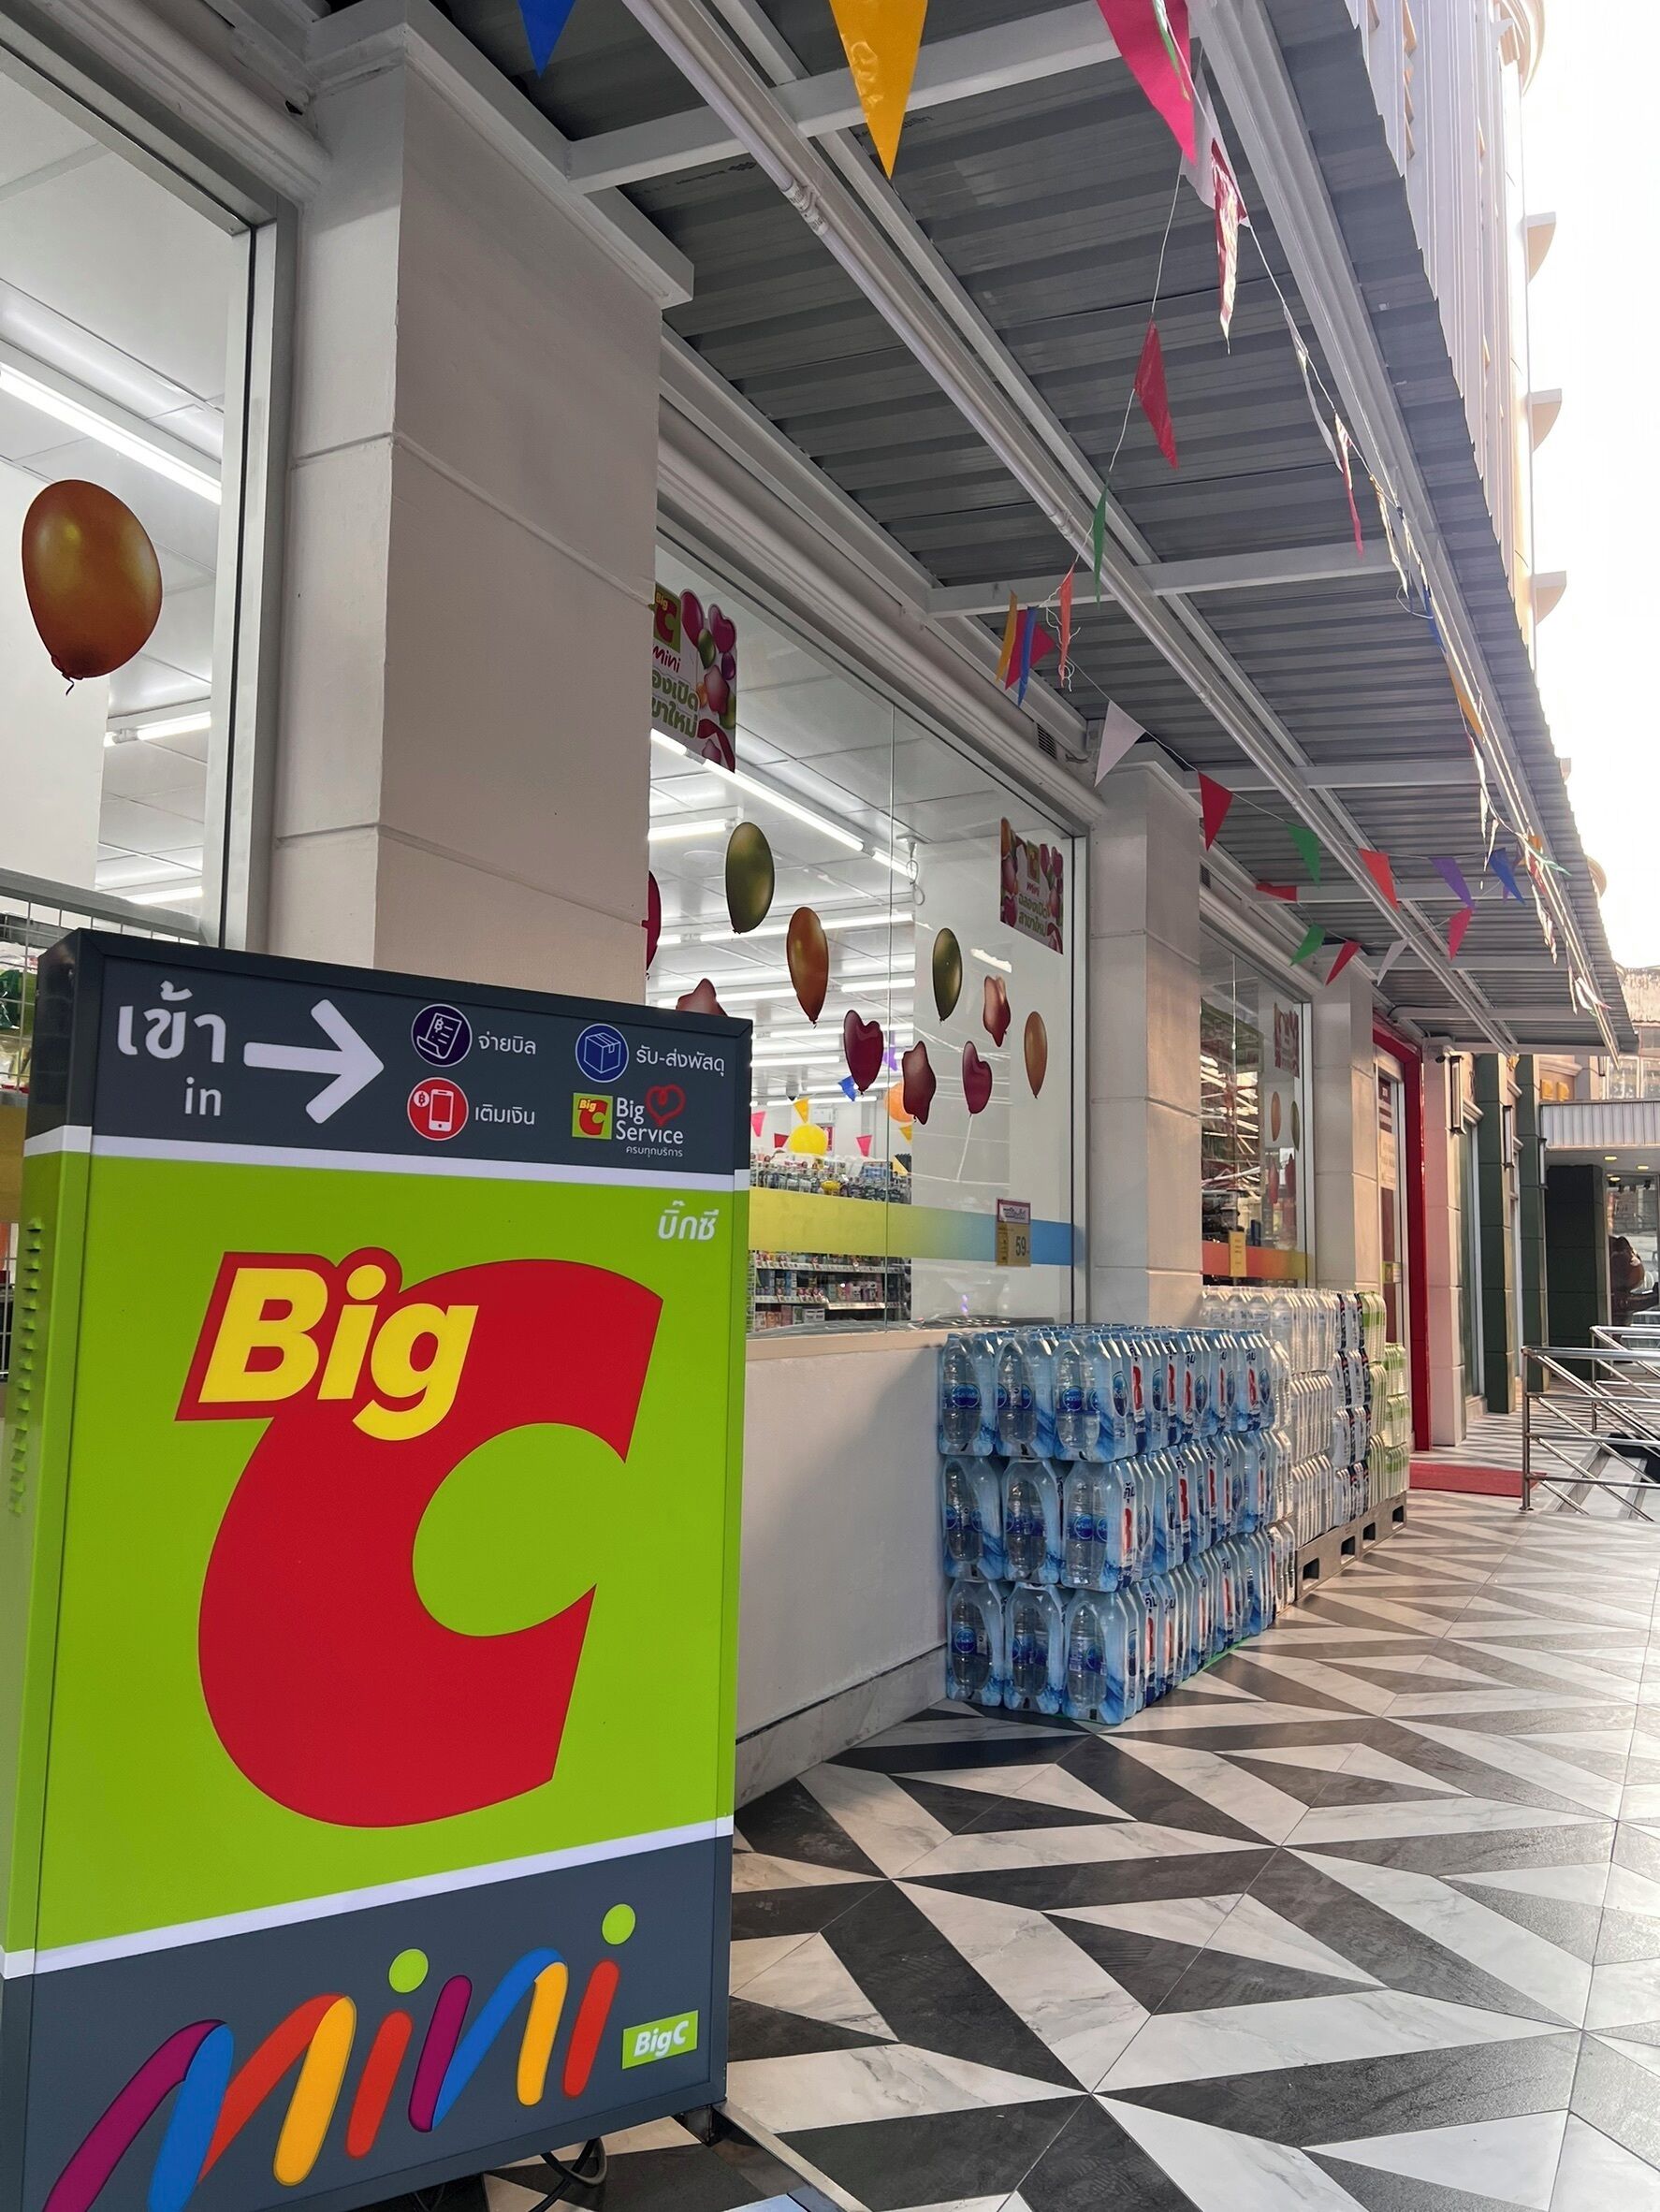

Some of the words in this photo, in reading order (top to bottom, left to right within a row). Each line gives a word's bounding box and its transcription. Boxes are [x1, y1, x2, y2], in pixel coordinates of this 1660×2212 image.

[118, 980, 226, 1063] เข้า
[478, 1031, 536, 1055] จ่ายบิล
[636, 1044, 725, 1077] รับ-ส่งพัสดุ
[184, 1076, 222, 1116] in
[578, 1099, 597, 1113] Big
[616, 1097, 645, 1125] Big
[475, 1104, 535, 1125] เติมเงิน
[616, 1119, 684, 1144] Service
[626, 1145, 683, 1158] ครบทุกบริการ
[658, 1200, 720, 1241] บิ๊กซี
[197, 1264, 480, 1442] Big
[197, 1259, 664, 1828] C
[41, 1903, 636, 2212] mini
